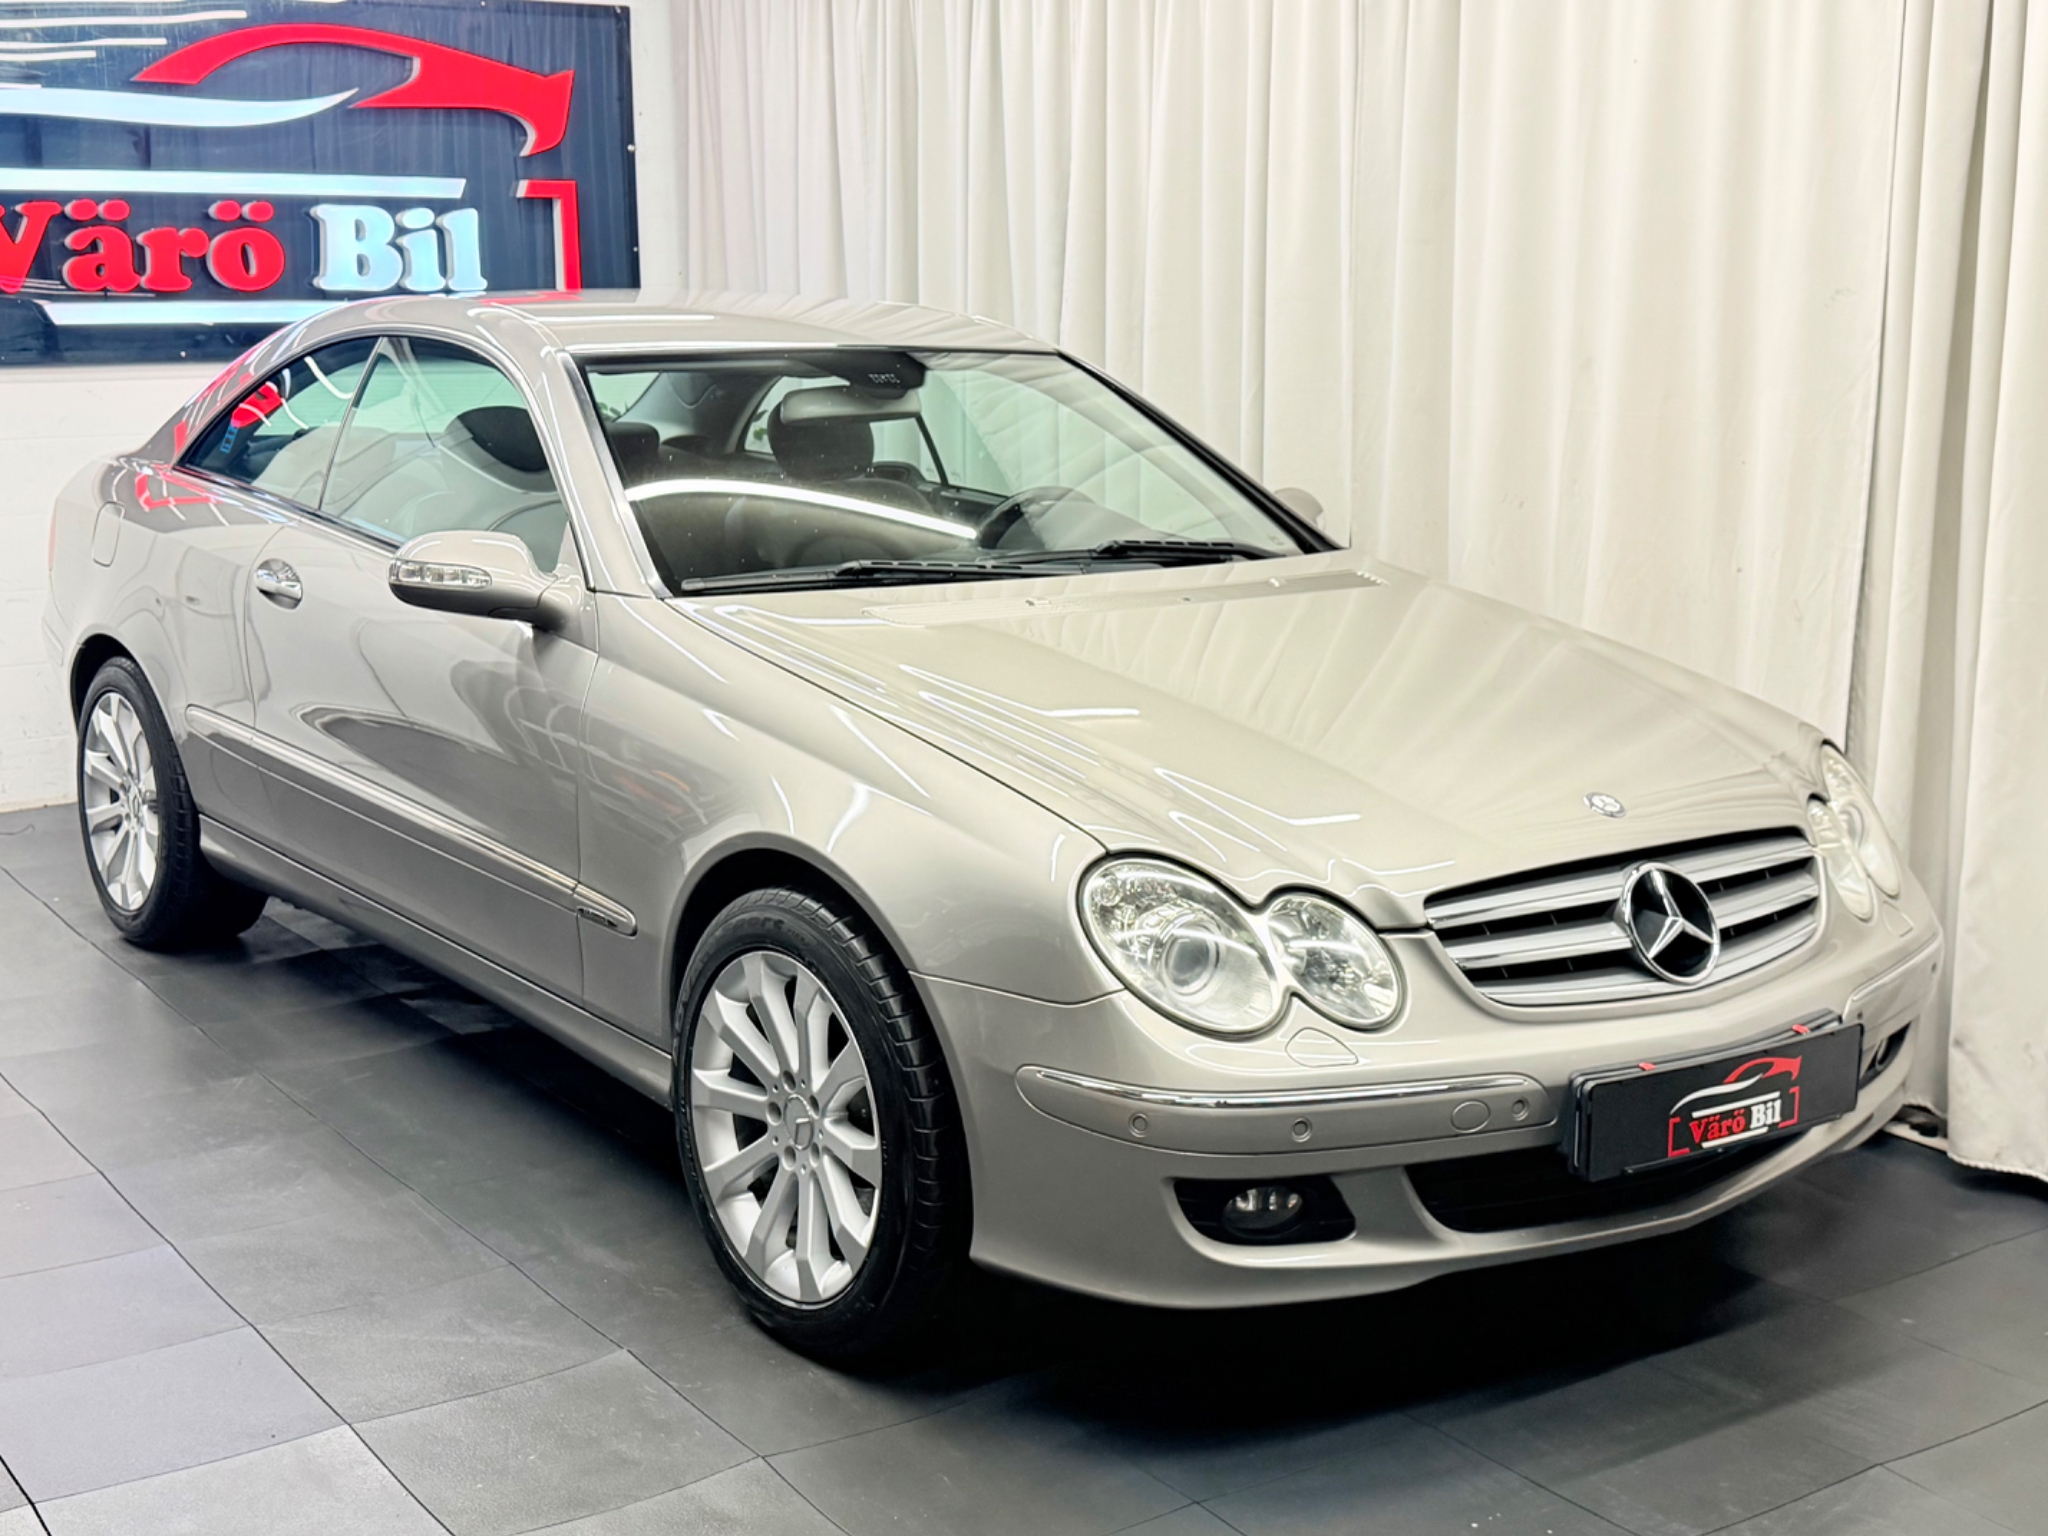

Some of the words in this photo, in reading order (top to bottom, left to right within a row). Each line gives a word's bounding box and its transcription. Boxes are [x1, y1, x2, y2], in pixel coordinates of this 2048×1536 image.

[312, 203, 487, 292] Bil
[1689, 1108, 1746, 1144] Värö
[1750, 1099, 1782, 1129] Bil
